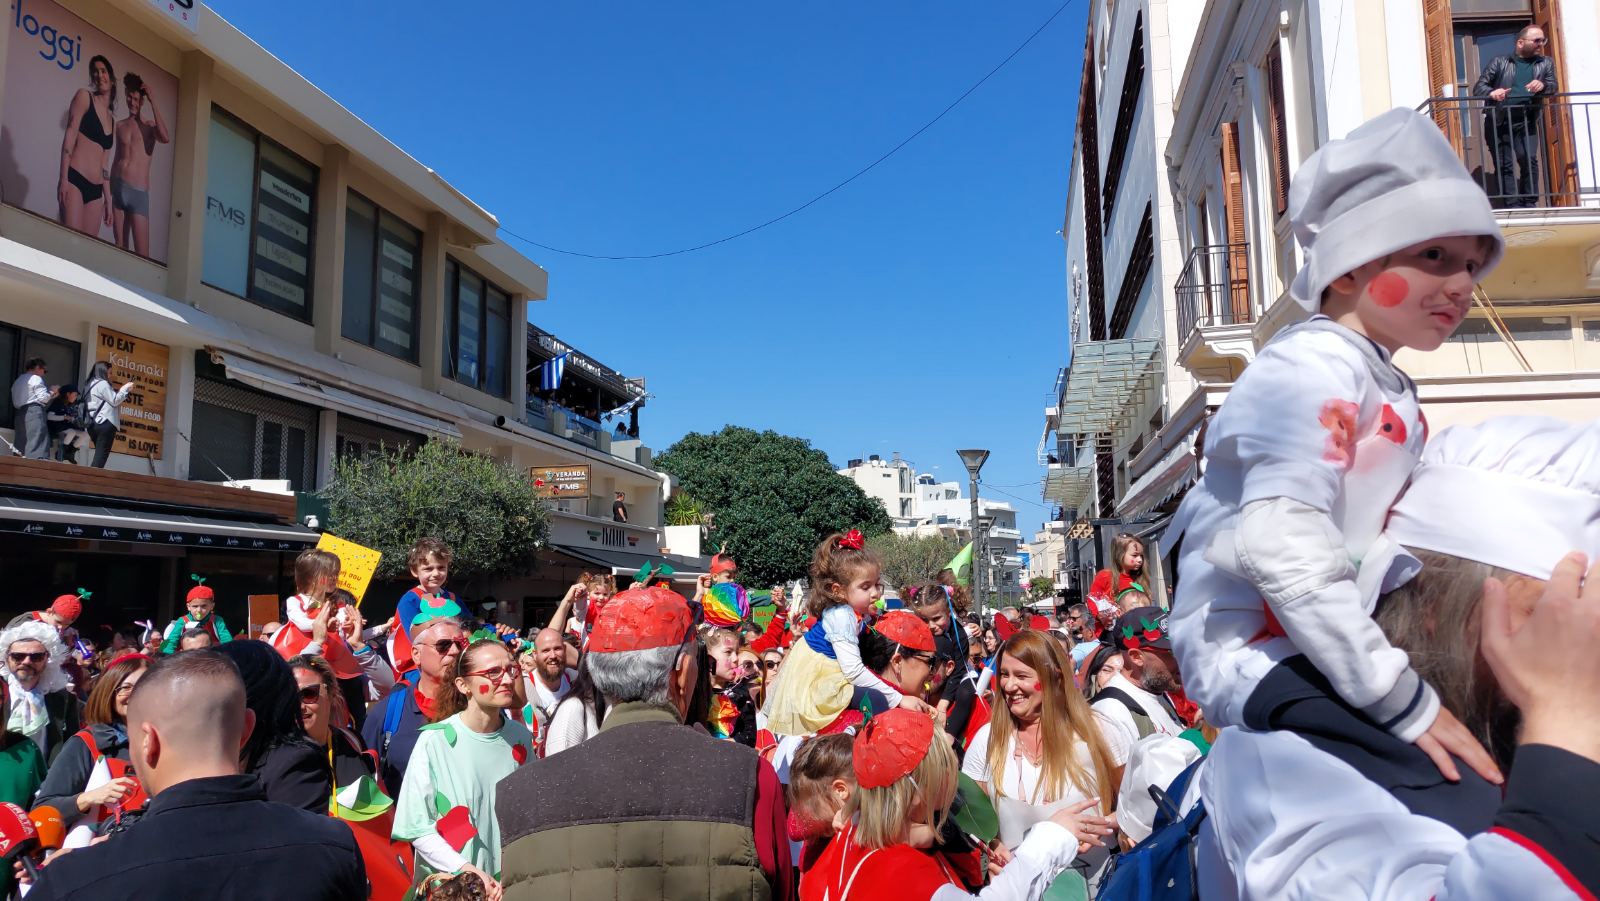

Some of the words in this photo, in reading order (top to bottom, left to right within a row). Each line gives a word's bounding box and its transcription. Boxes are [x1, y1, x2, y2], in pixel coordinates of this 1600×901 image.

[12, 0, 81, 70] loggi
[207, 196, 246, 226] FMS
[101, 333, 114, 347] TO
[117, 338, 135, 353] EAT
[109, 352, 164, 377] Kalamaki
[123, 392, 144, 406] STE
[121, 406, 143, 418] URBAN
[144, 412, 161, 422] FOOD
[128, 439, 137, 449] IS
[138, 441, 159, 453] LOVE
